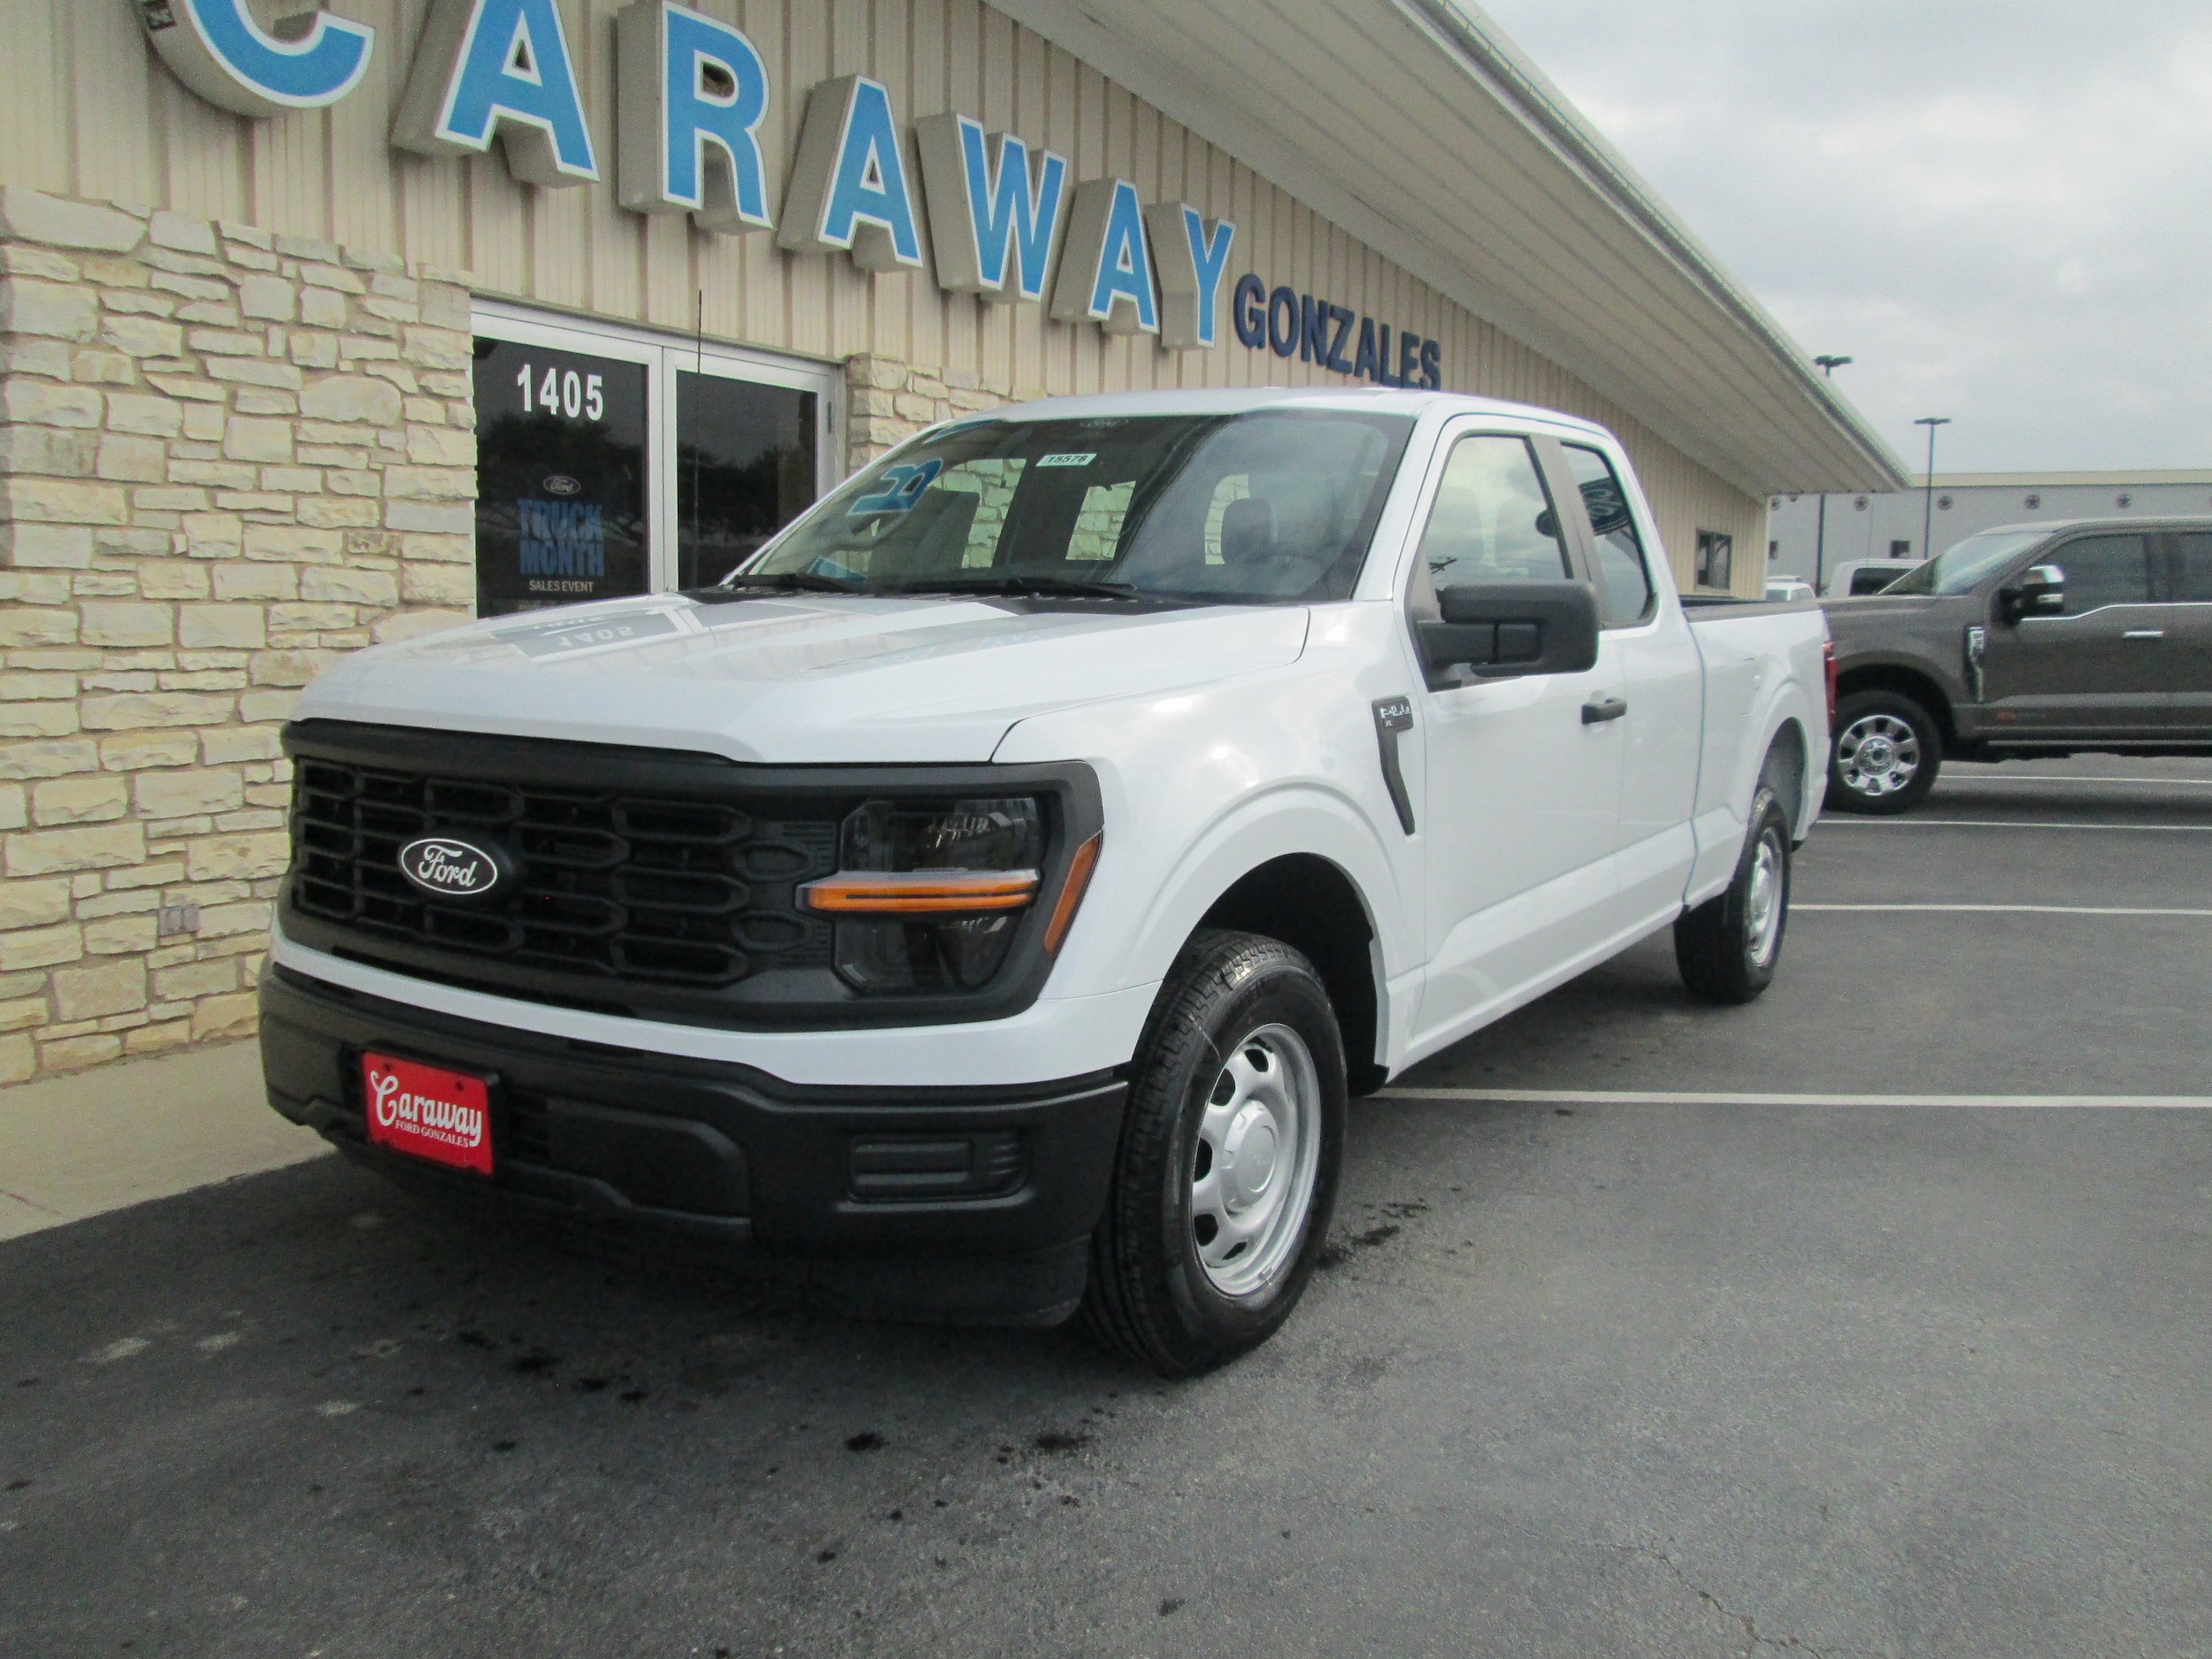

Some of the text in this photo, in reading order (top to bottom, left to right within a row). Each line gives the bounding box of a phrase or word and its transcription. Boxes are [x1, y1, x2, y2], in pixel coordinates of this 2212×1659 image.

[1233, 273, 1441, 390] GONZALES
[517, 364, 603, 420] 1405
[517, 498, 603, 541] TRUCK
[520, 539, 604, 577] MONTH
[529, 580, 594, 593] SALES EVENT
[418, 844, 477, 887] Ford
[370, 1070, 482, 1148] Caraway
[396, 1119, 470, 1148] FORD GONZALES
